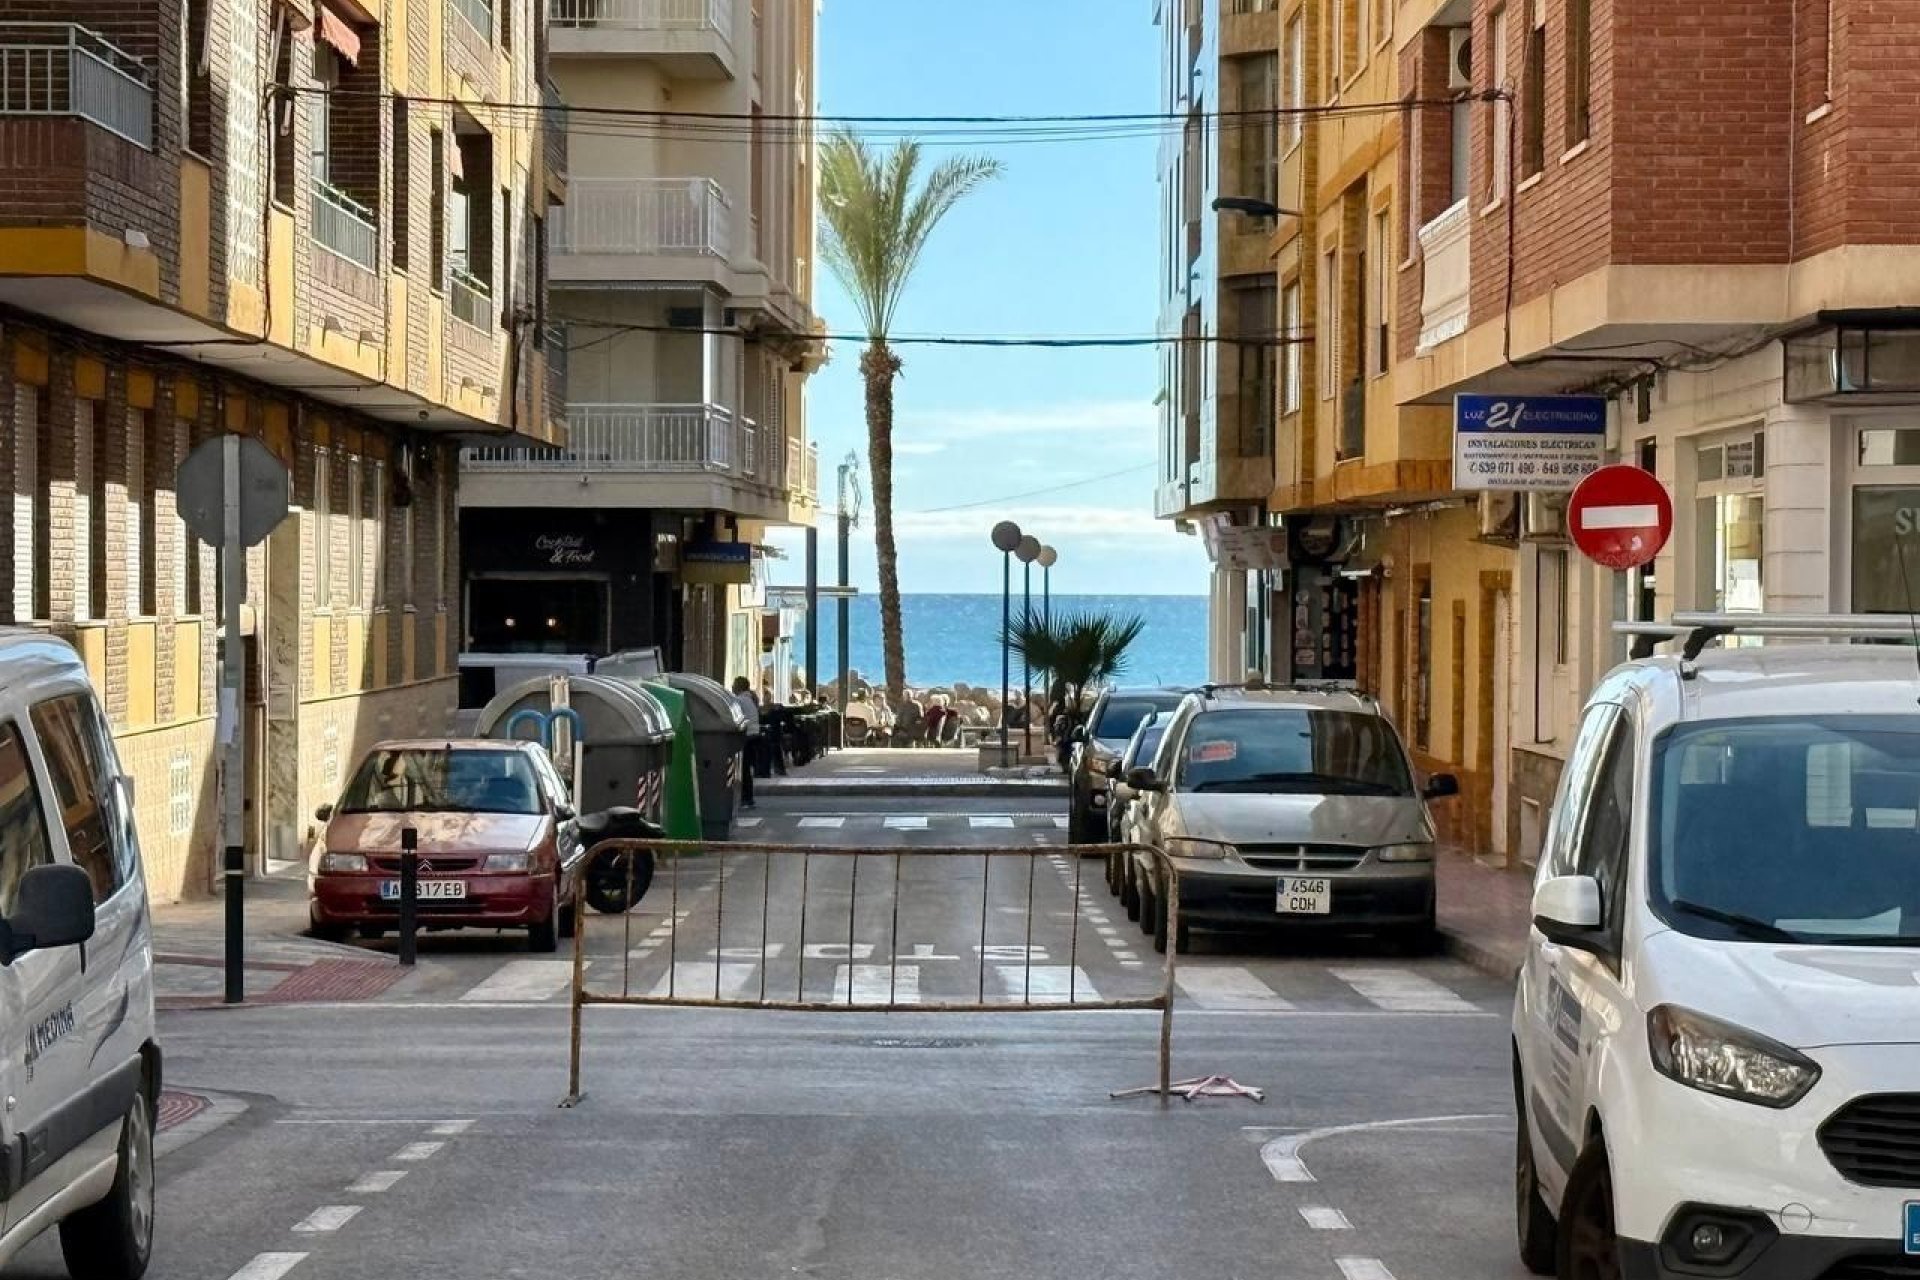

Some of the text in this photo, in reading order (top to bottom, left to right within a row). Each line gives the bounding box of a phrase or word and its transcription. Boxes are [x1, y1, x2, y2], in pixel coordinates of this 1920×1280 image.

[1464, 411, 1485, 420] LUZ
[1486, 402, 1525, 429] 21
[1468, 440, 1537, 449] INSTALACIONES
